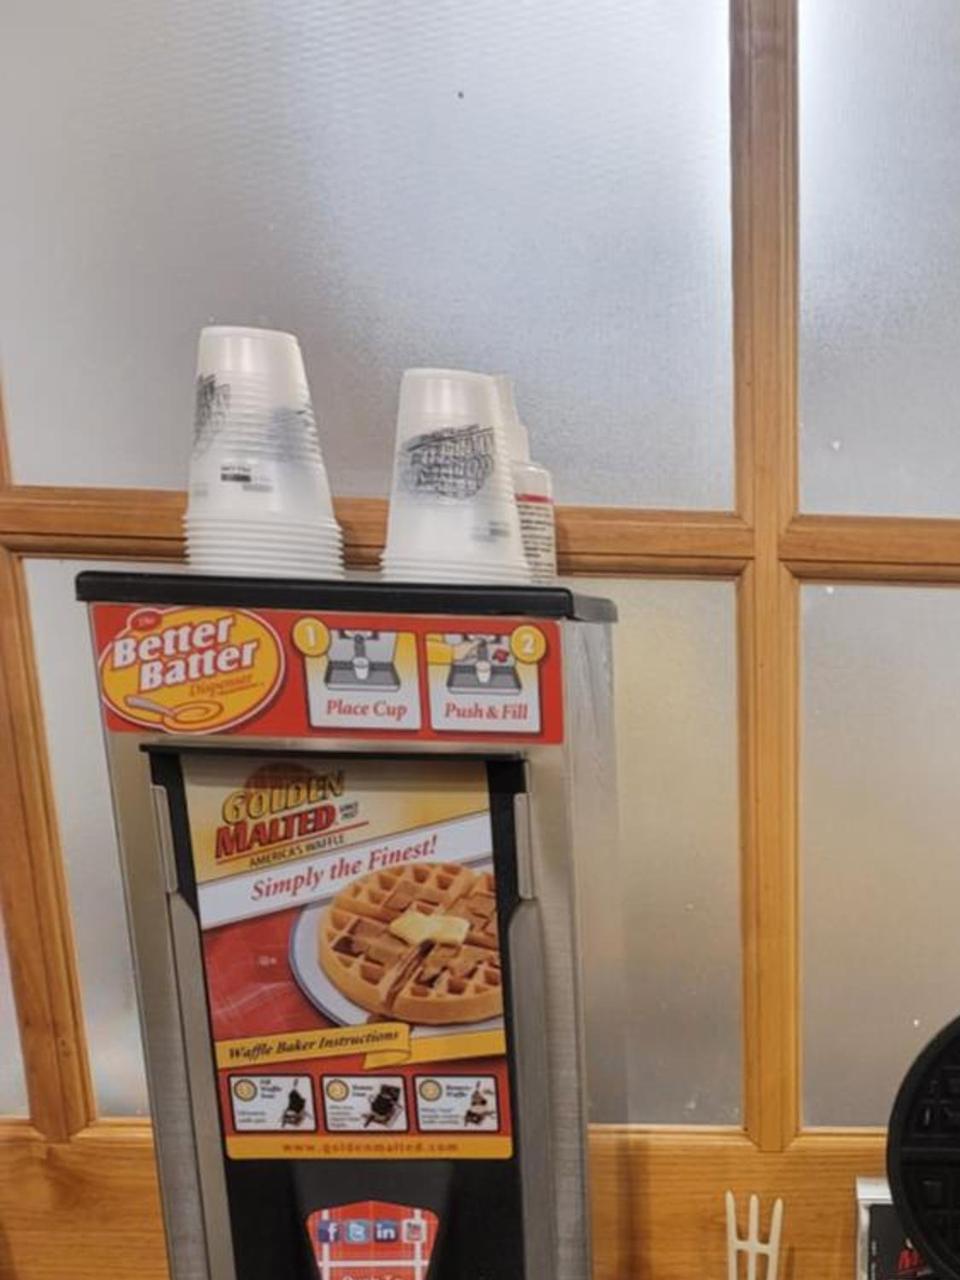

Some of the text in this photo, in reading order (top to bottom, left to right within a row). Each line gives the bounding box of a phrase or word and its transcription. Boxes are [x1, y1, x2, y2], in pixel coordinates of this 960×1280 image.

[112, 616, 236, 670] Better
[308, 627, 316, 648] 1
[521, 635, 535, 655] 2
[140, 640, 259, 693] Batter
[326, 699, 408, 721] Place Cup
[444, 702, 529, 720] Push & Fill
[221, 771, 345, 825] GOLDEN
[215, 803, 337, 859] MALTED
[304, 835, 345, 852] WAFFLE
[251, 834, 438, 900] Simply the Finest!
[228, 1029, 399, 1061] Waffle Baker Instructions
[281, 1141, 460, 1156] www.goldenmalted.com
